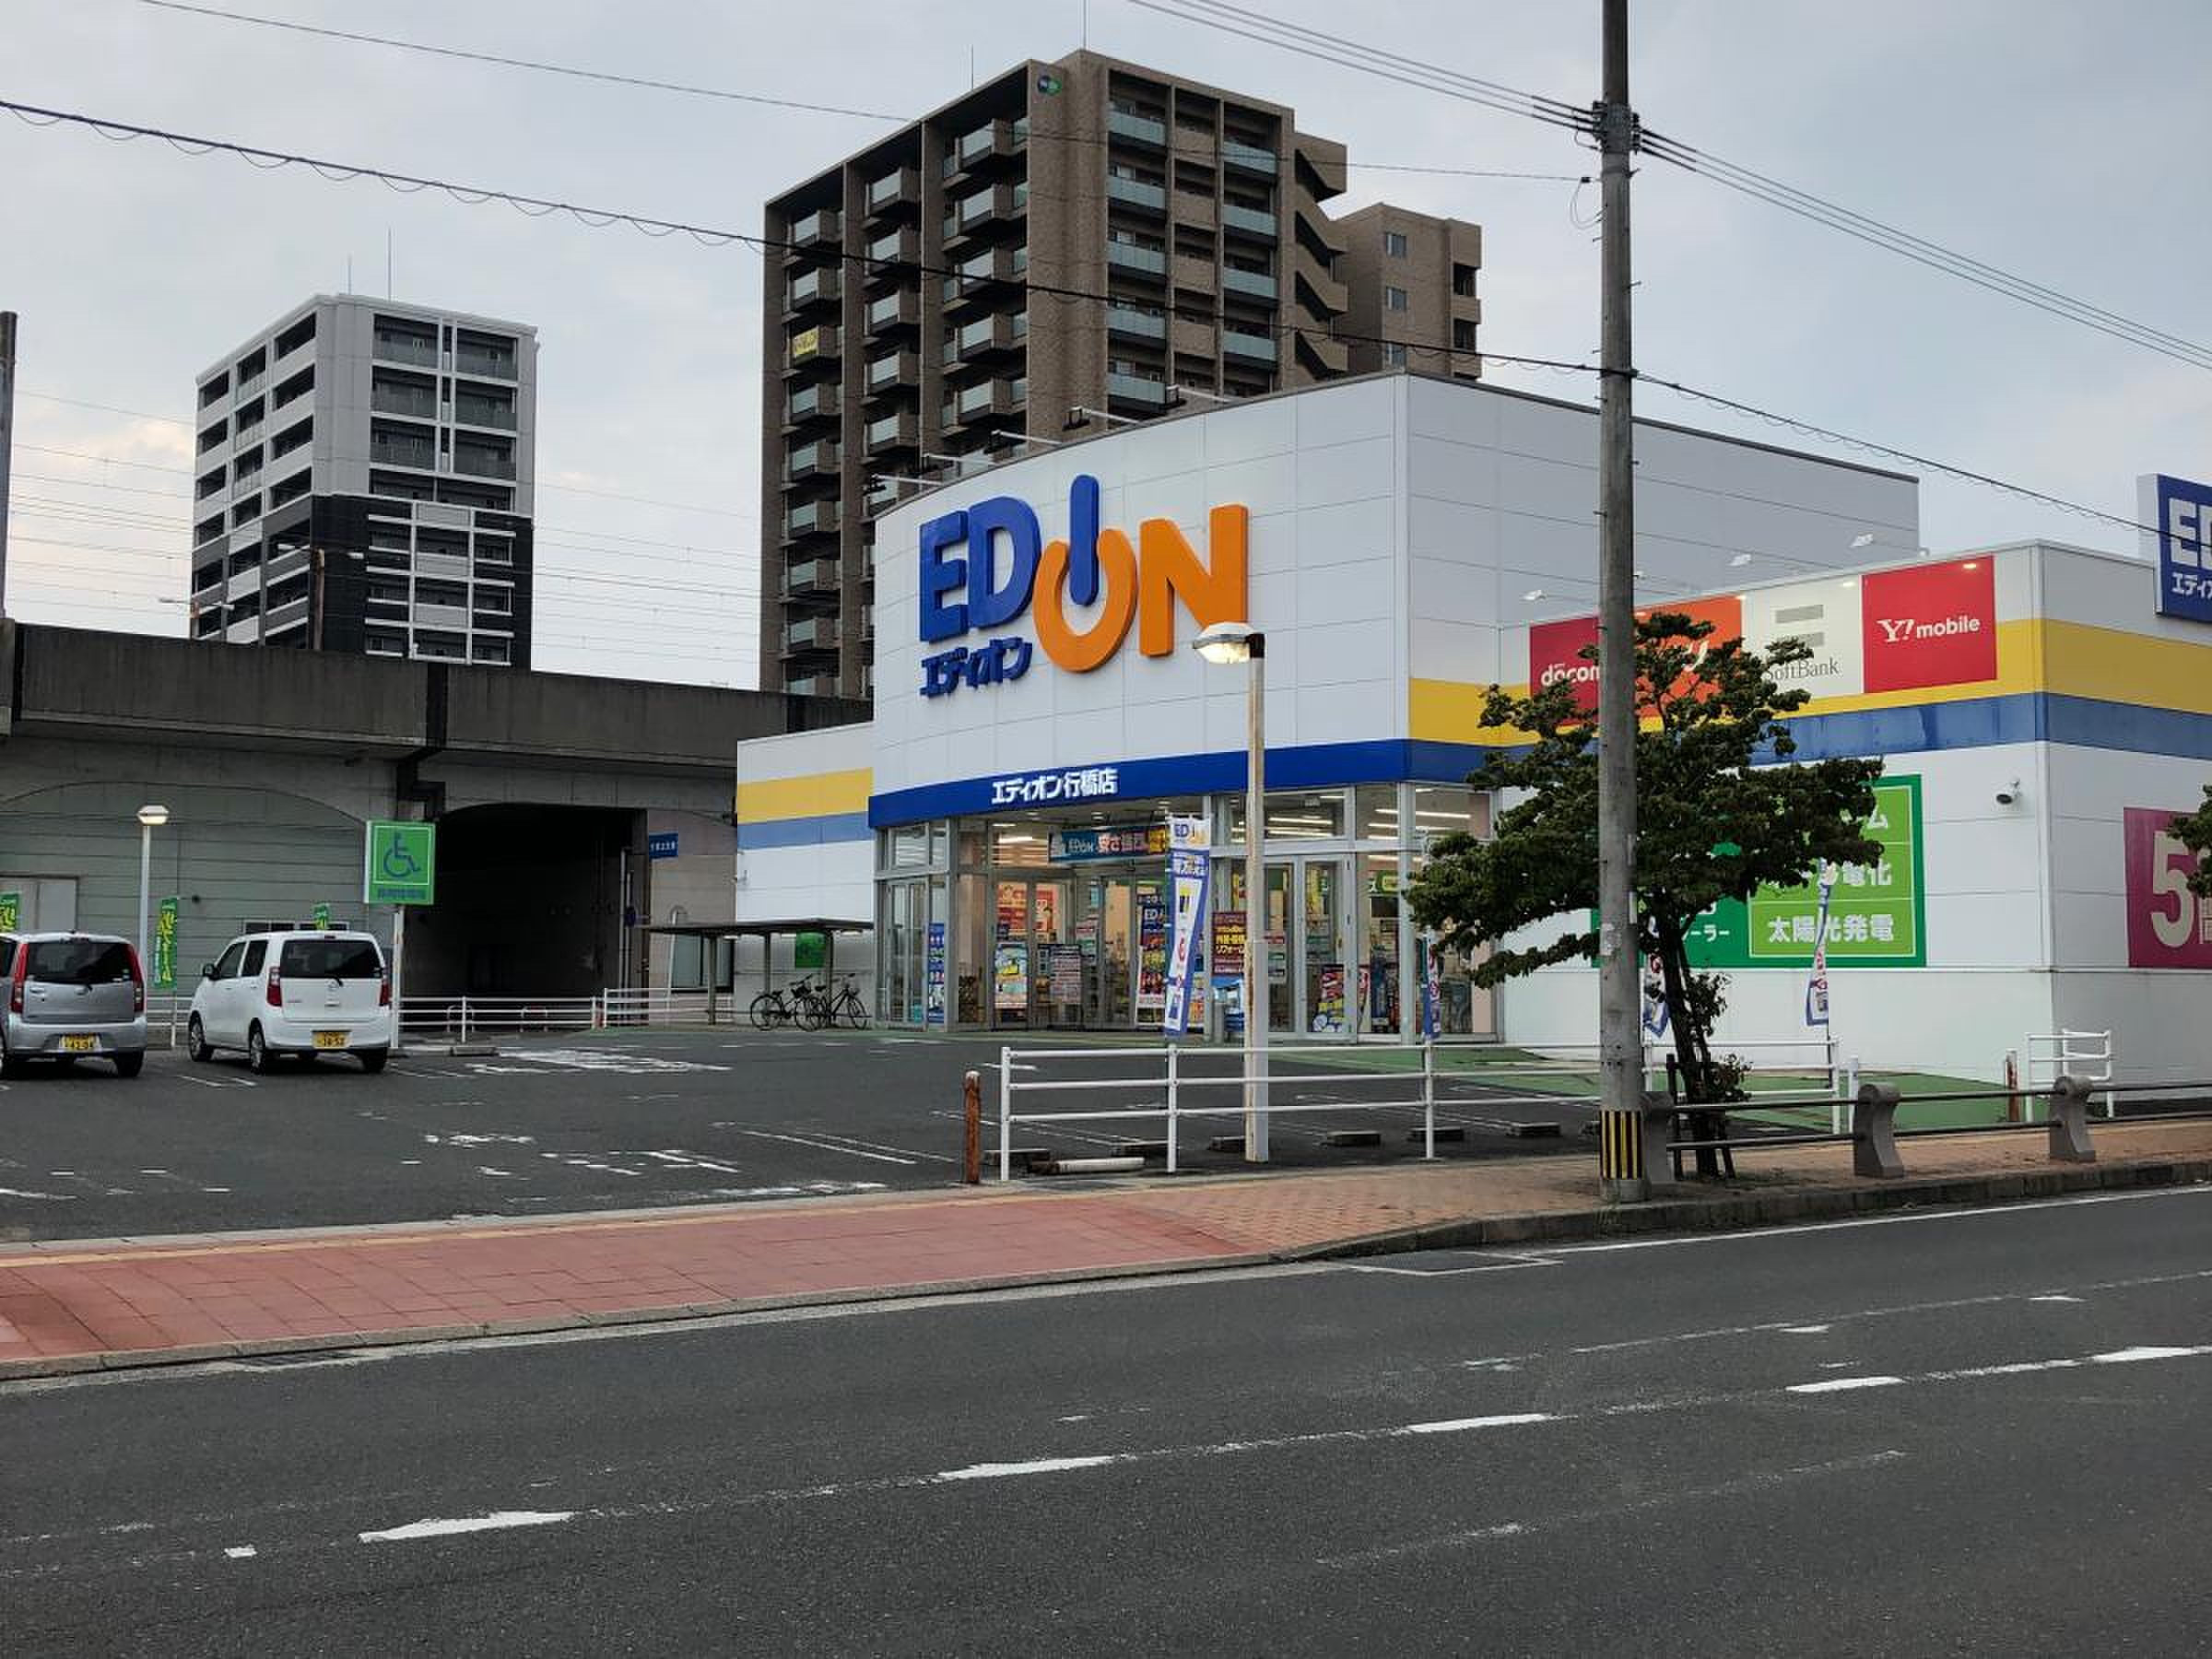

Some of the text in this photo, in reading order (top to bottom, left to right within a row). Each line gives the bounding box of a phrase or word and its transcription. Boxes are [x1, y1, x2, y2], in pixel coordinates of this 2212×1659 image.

[920, 474, 1249, 673] EDION
[1877, 616, 1981, 642] Y! mobile
[920, 637, 1033, 698] エディオン
[1765, 657, 1840, 682] SoftBank
[992, 768, 1118, 805] エディオン行橋店
[1768, 913, 1895, 944] 太陽光発電
